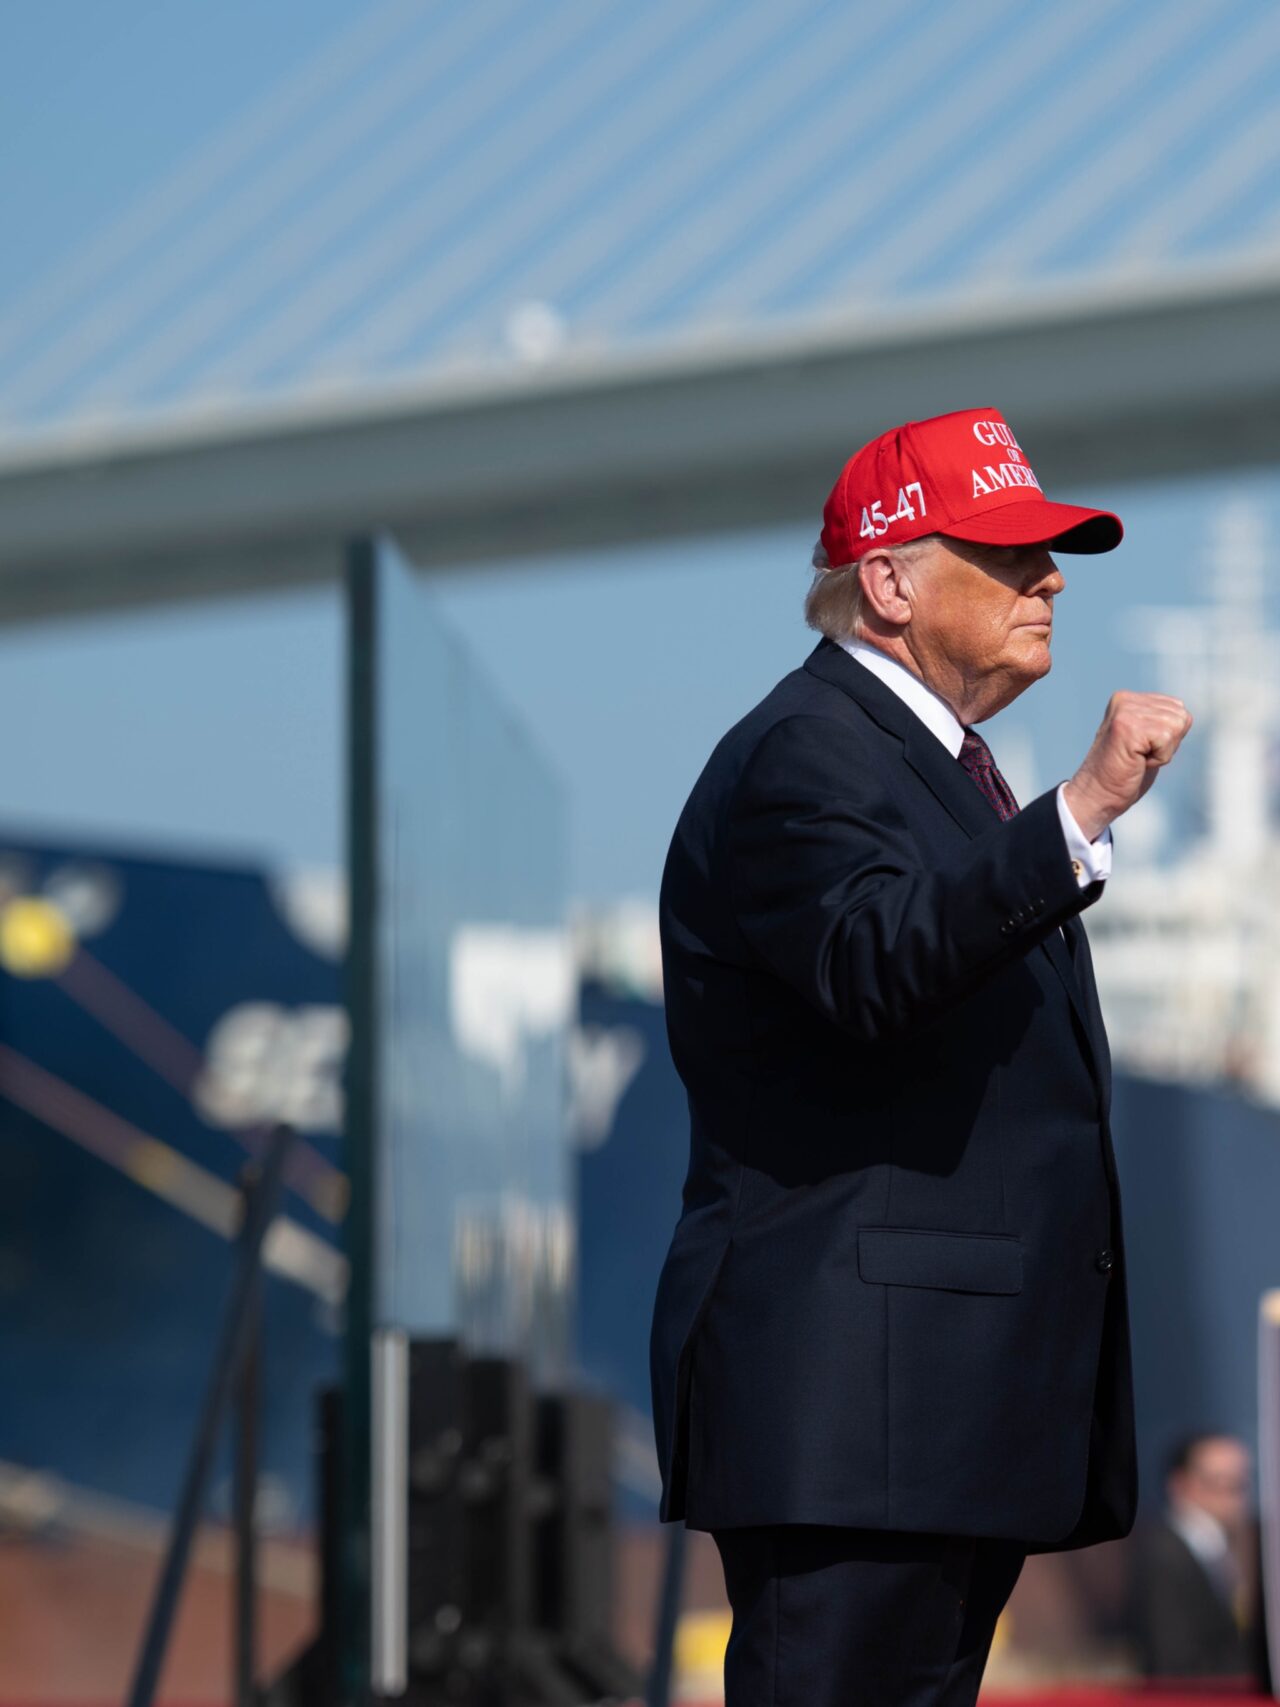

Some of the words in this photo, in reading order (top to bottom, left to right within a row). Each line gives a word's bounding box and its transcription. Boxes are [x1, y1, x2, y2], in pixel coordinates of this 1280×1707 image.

[973, 421, 1023, 452] GUL
[971, 463, 1043, 498] AMERI
[859, 481, 927, 540] 45-47
